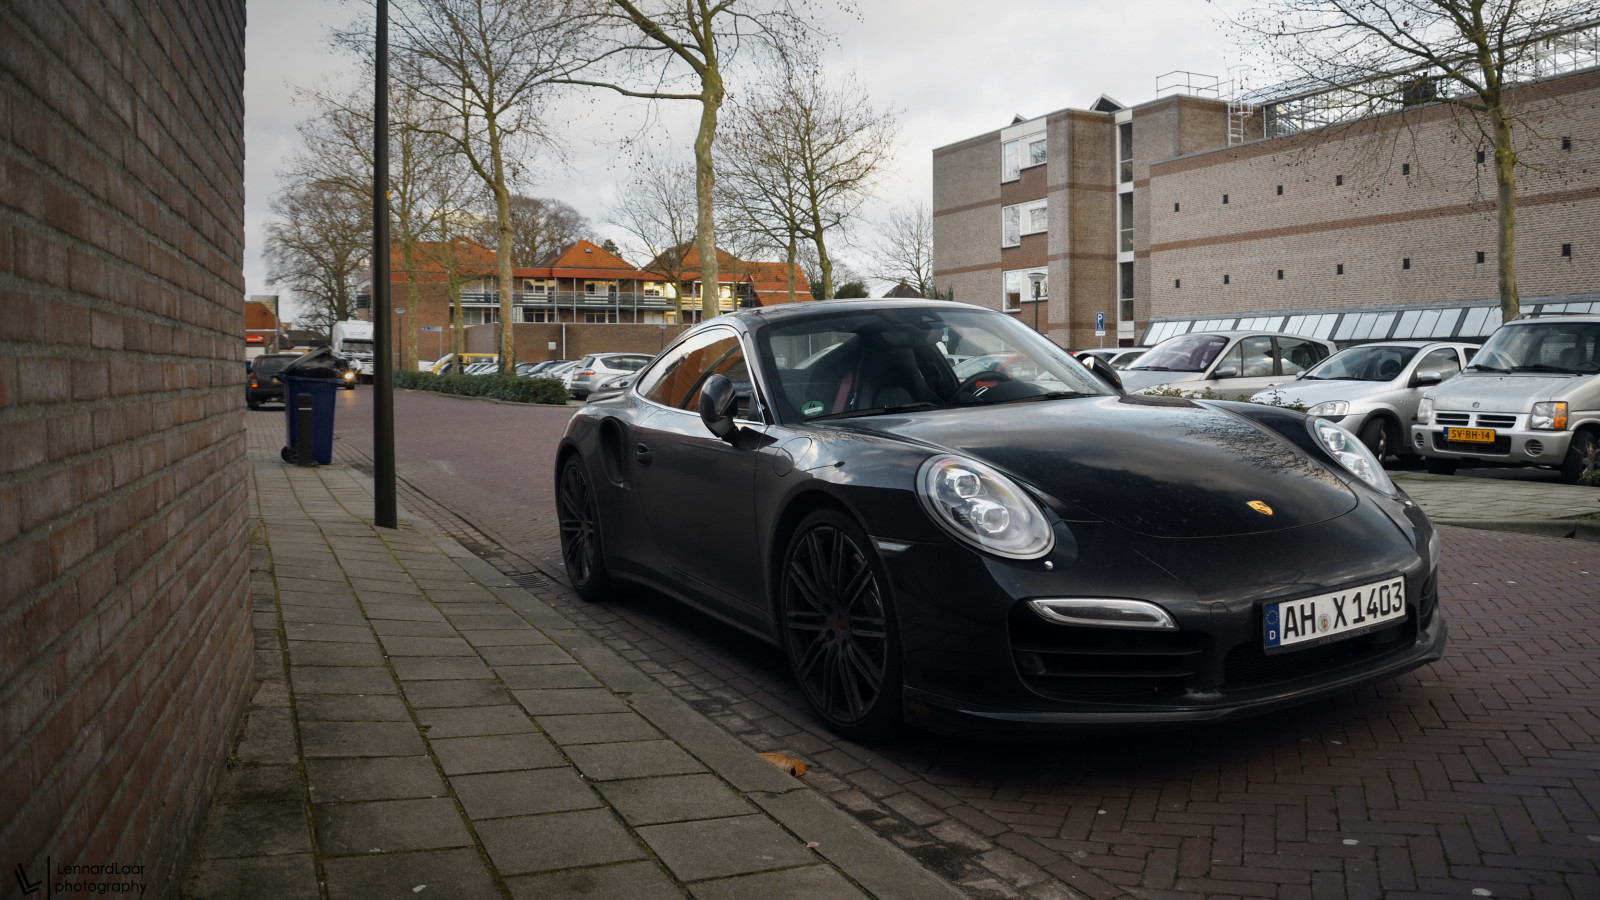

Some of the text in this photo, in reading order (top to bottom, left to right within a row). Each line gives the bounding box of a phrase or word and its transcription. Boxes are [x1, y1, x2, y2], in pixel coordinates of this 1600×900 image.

[1097, 313, 1103, 323] P
[1451, 429, 1490, 440] SV-BH-14
[1283, 601, 1316, 640] AH
[1269, 630, 1276, 640] D
